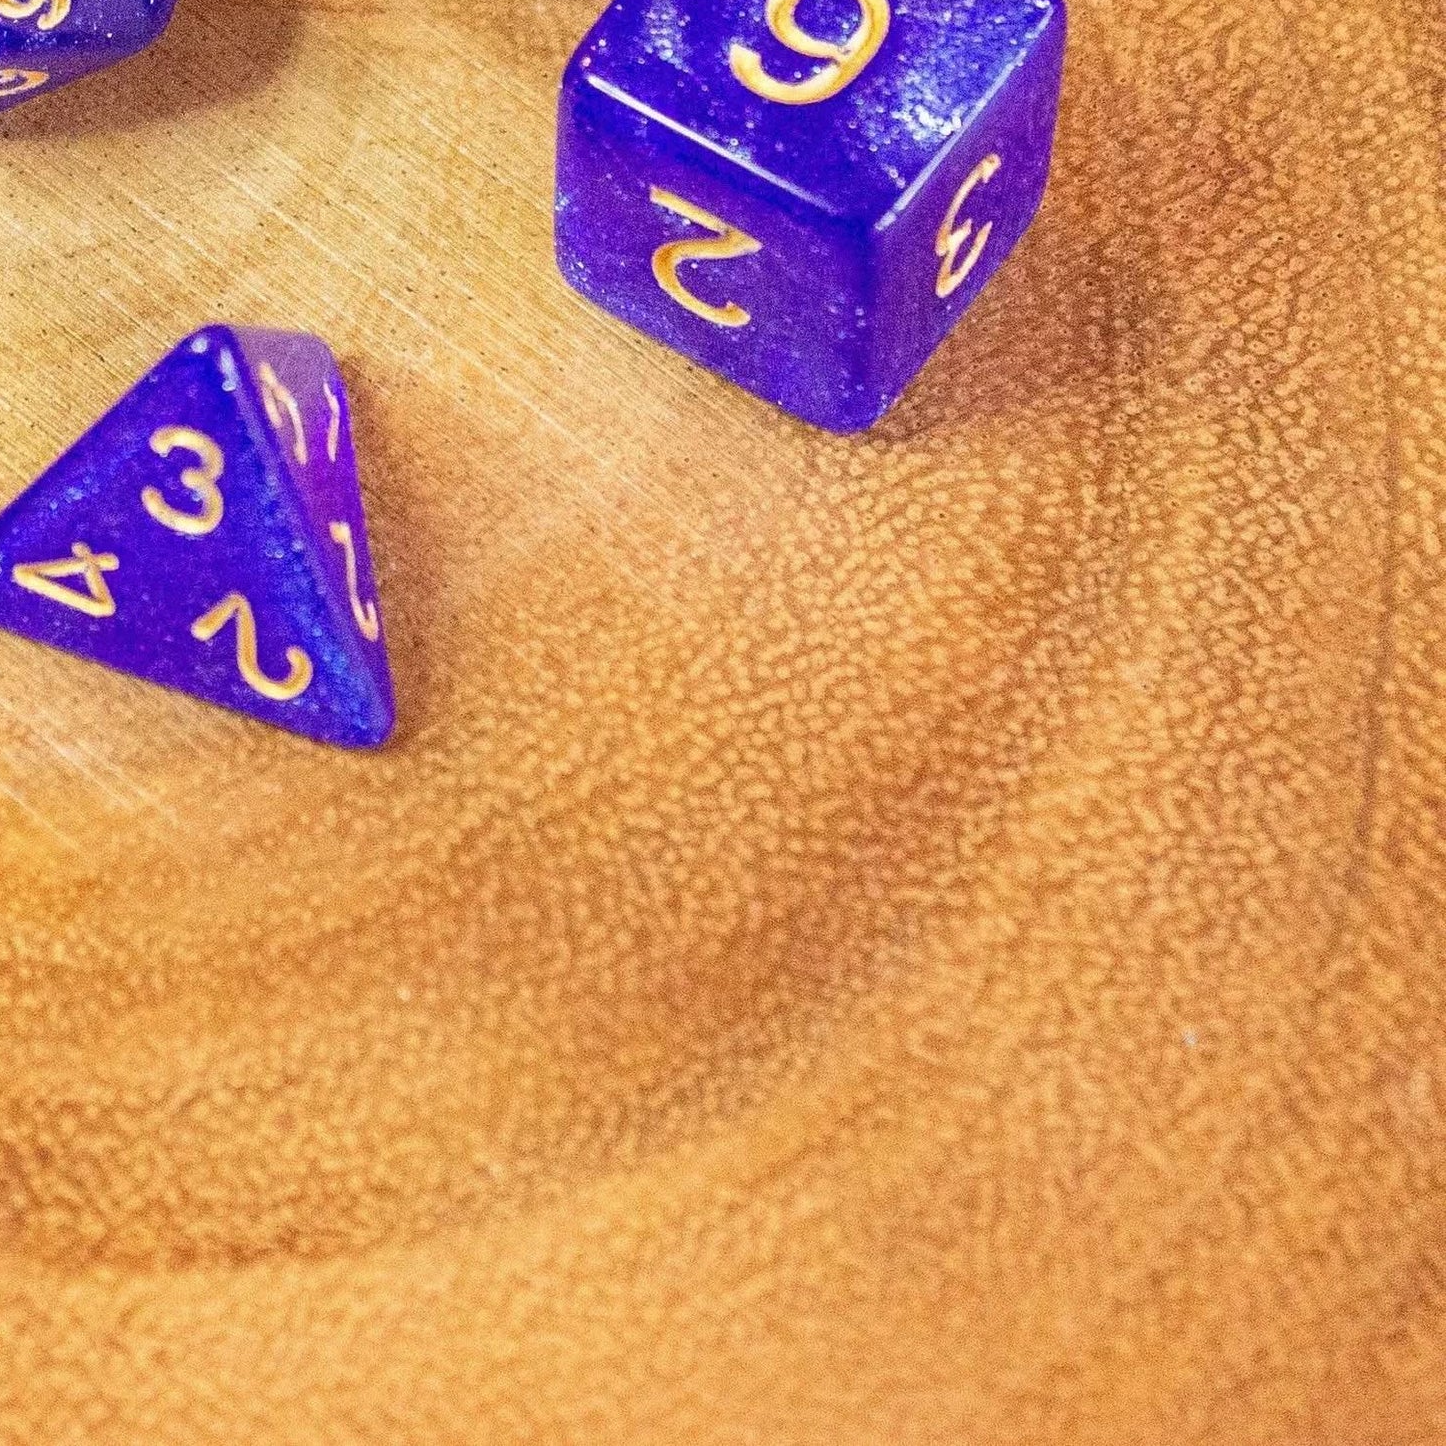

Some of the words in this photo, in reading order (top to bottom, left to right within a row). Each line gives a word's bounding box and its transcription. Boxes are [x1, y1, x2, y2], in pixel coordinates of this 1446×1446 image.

[650, 187, 763, 328] 2
[934, 154, 1002, 299] 3
[141, 425, 225, 537] 3
[11, 540, 121, 618] 4
[190, 592, 314, 700] 2
